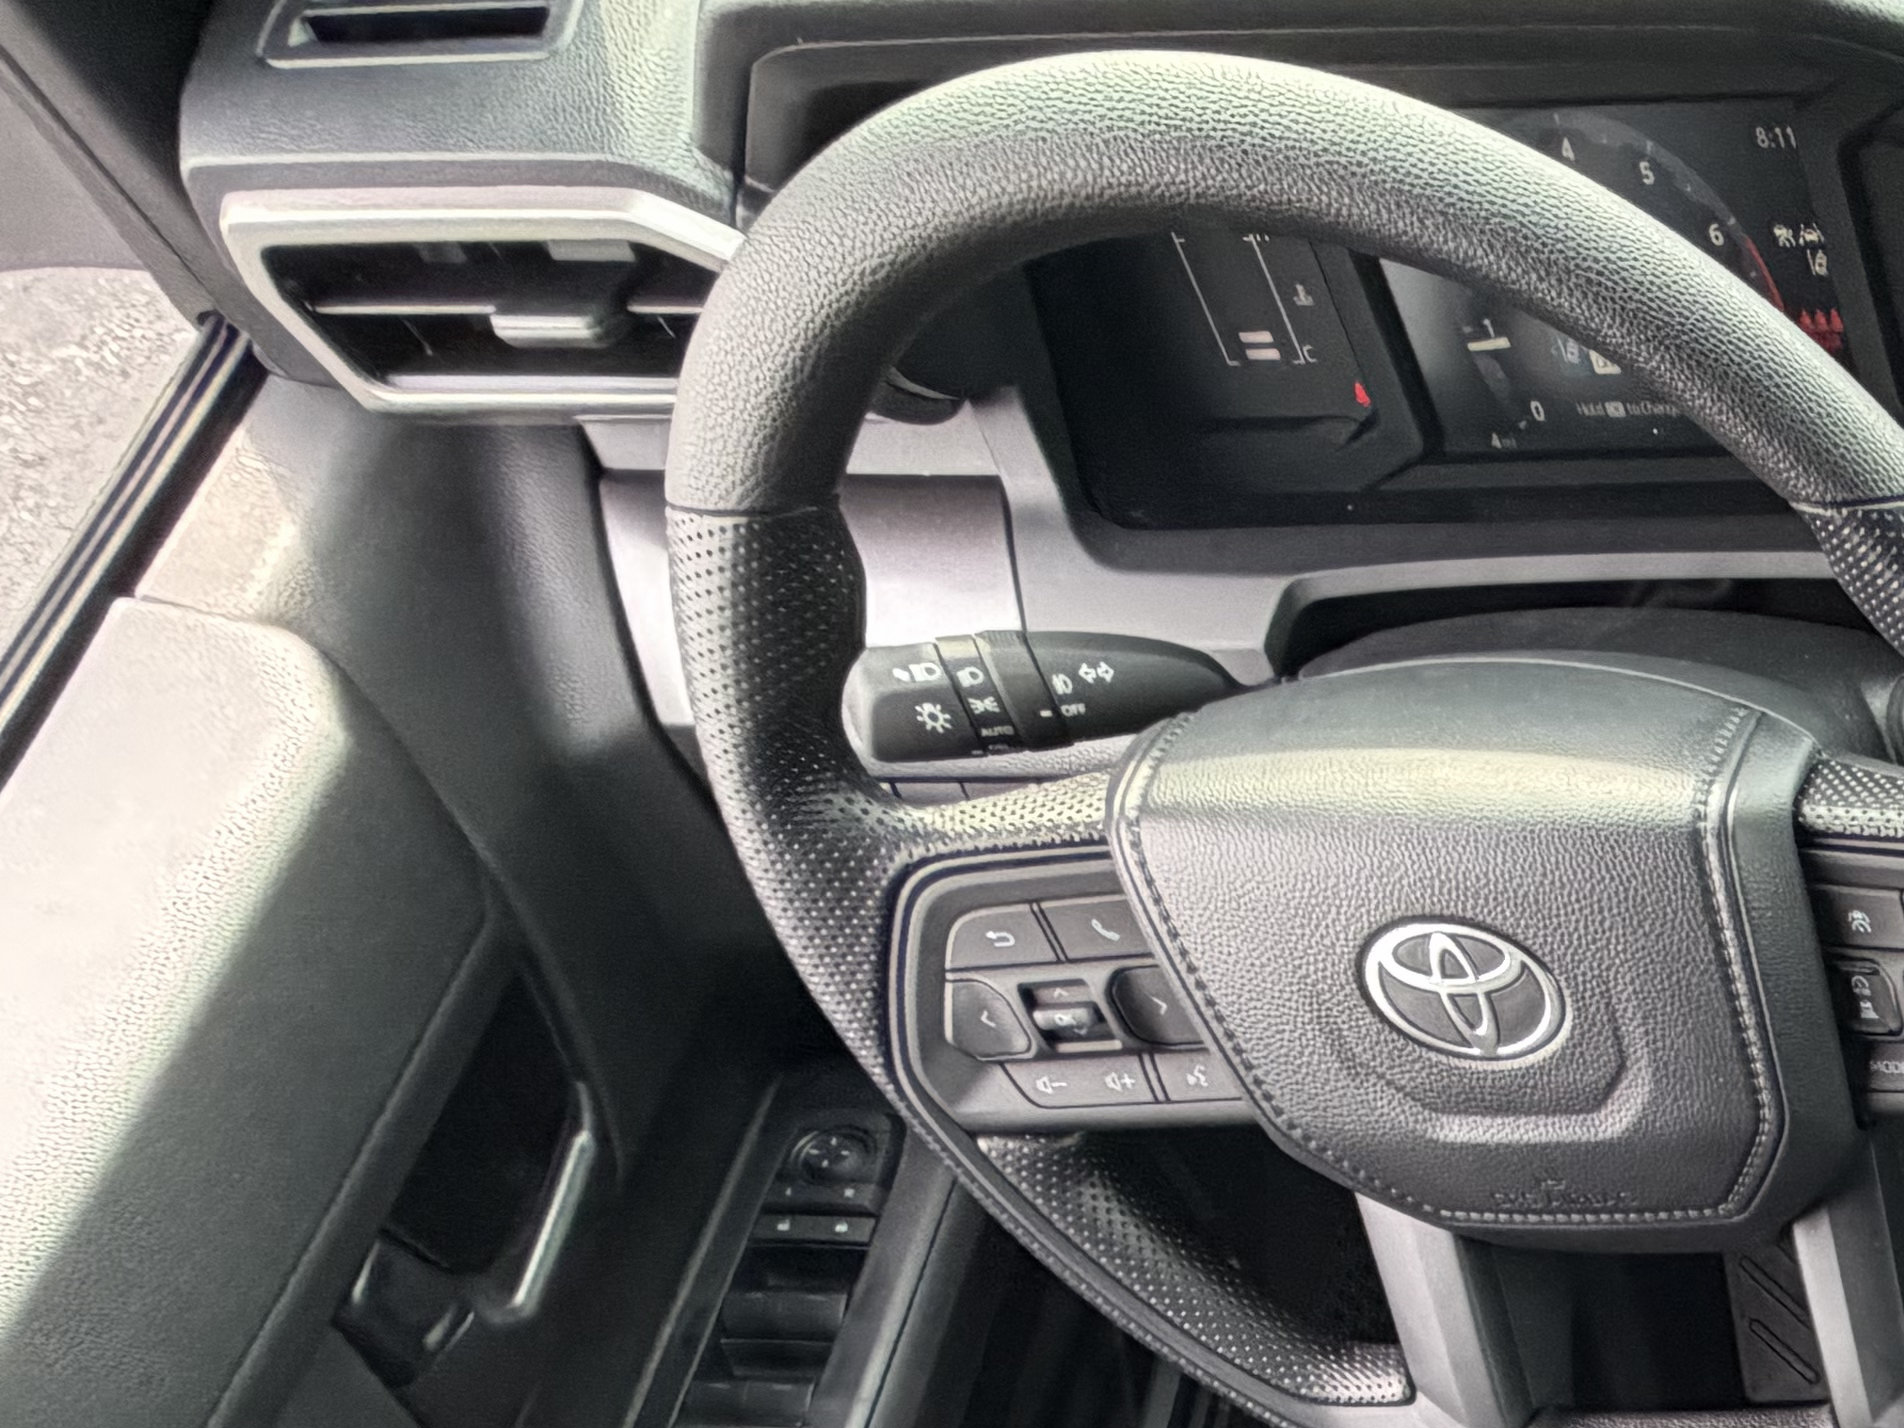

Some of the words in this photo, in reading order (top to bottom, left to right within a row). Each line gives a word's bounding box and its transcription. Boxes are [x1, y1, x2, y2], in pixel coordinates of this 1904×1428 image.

[1755, 126, 1798, 149] 8:11
[1639, 161, 1655, 185] 5
[1708, 223, 1725, 246] 6
